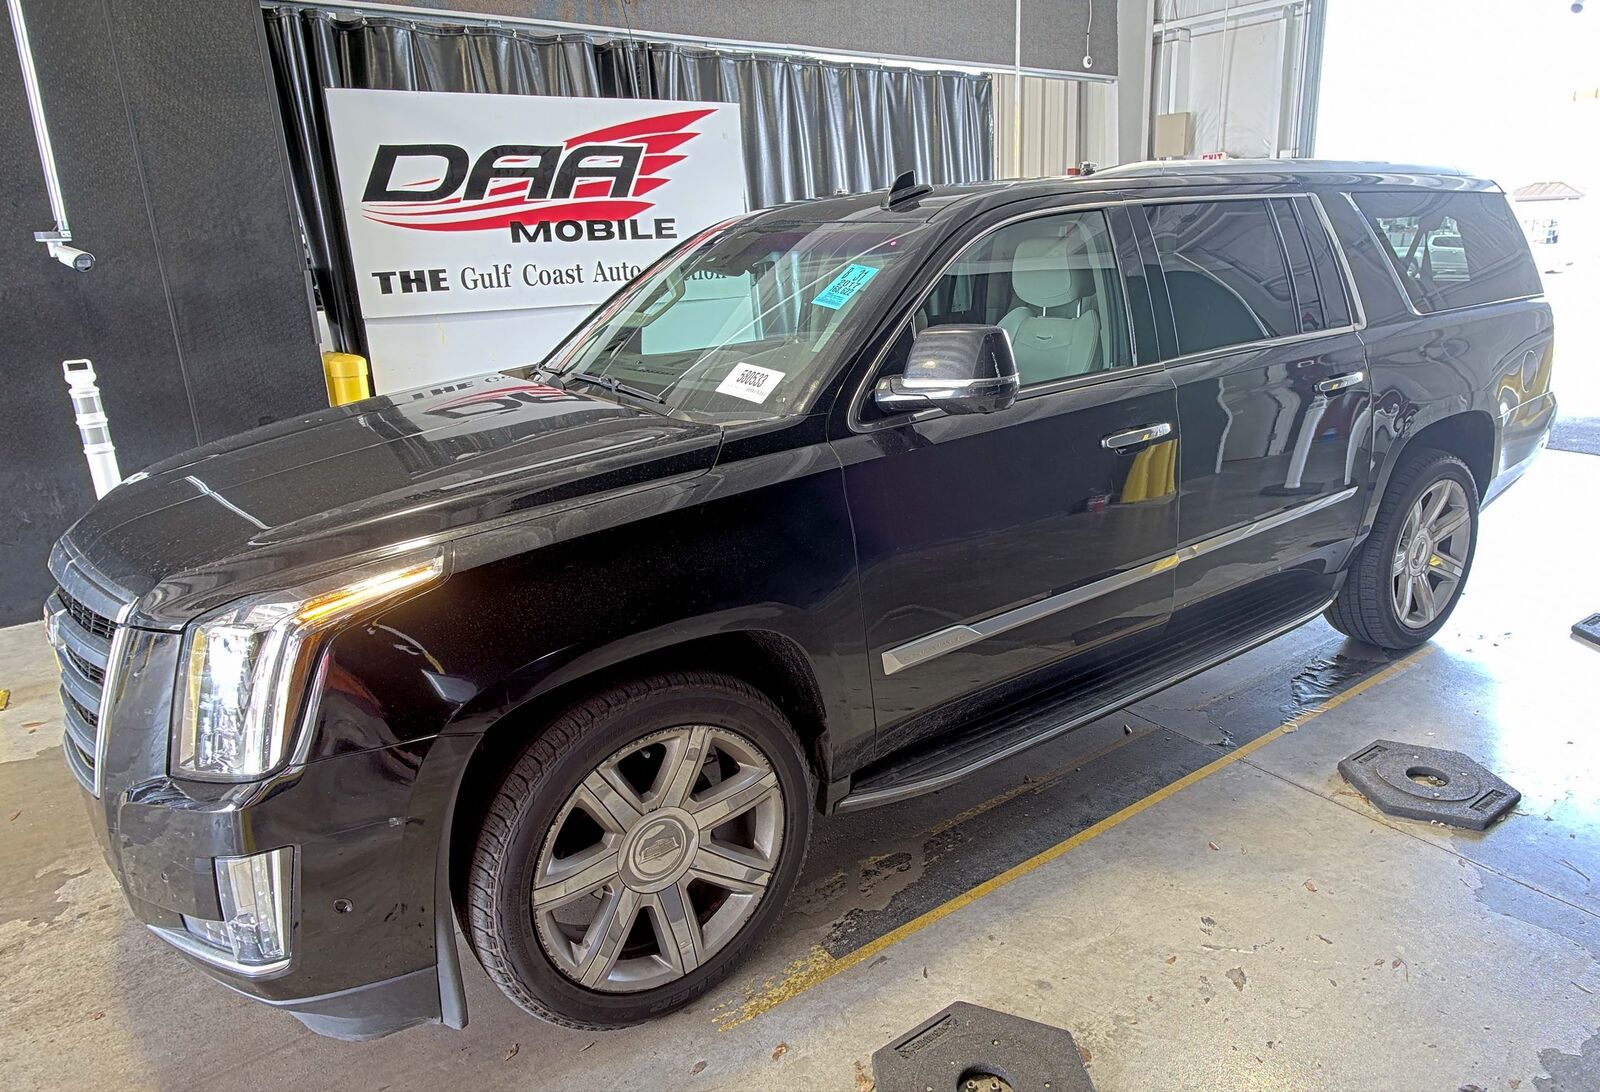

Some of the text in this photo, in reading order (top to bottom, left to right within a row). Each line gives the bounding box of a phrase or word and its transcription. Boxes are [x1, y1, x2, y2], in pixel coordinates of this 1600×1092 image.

[362, 144, 645, 202] DAA
[510, 218, 678, 243] MOBILE
[371, 268, 450, 295] THE
[460, 263, 512, 291] Gulf
[522, 263, 585, 287] Coast
[593, 260, 642, 283] Auto
[836, 279, 861, 289] 2017
[736, 369, 769, 388] 580533
